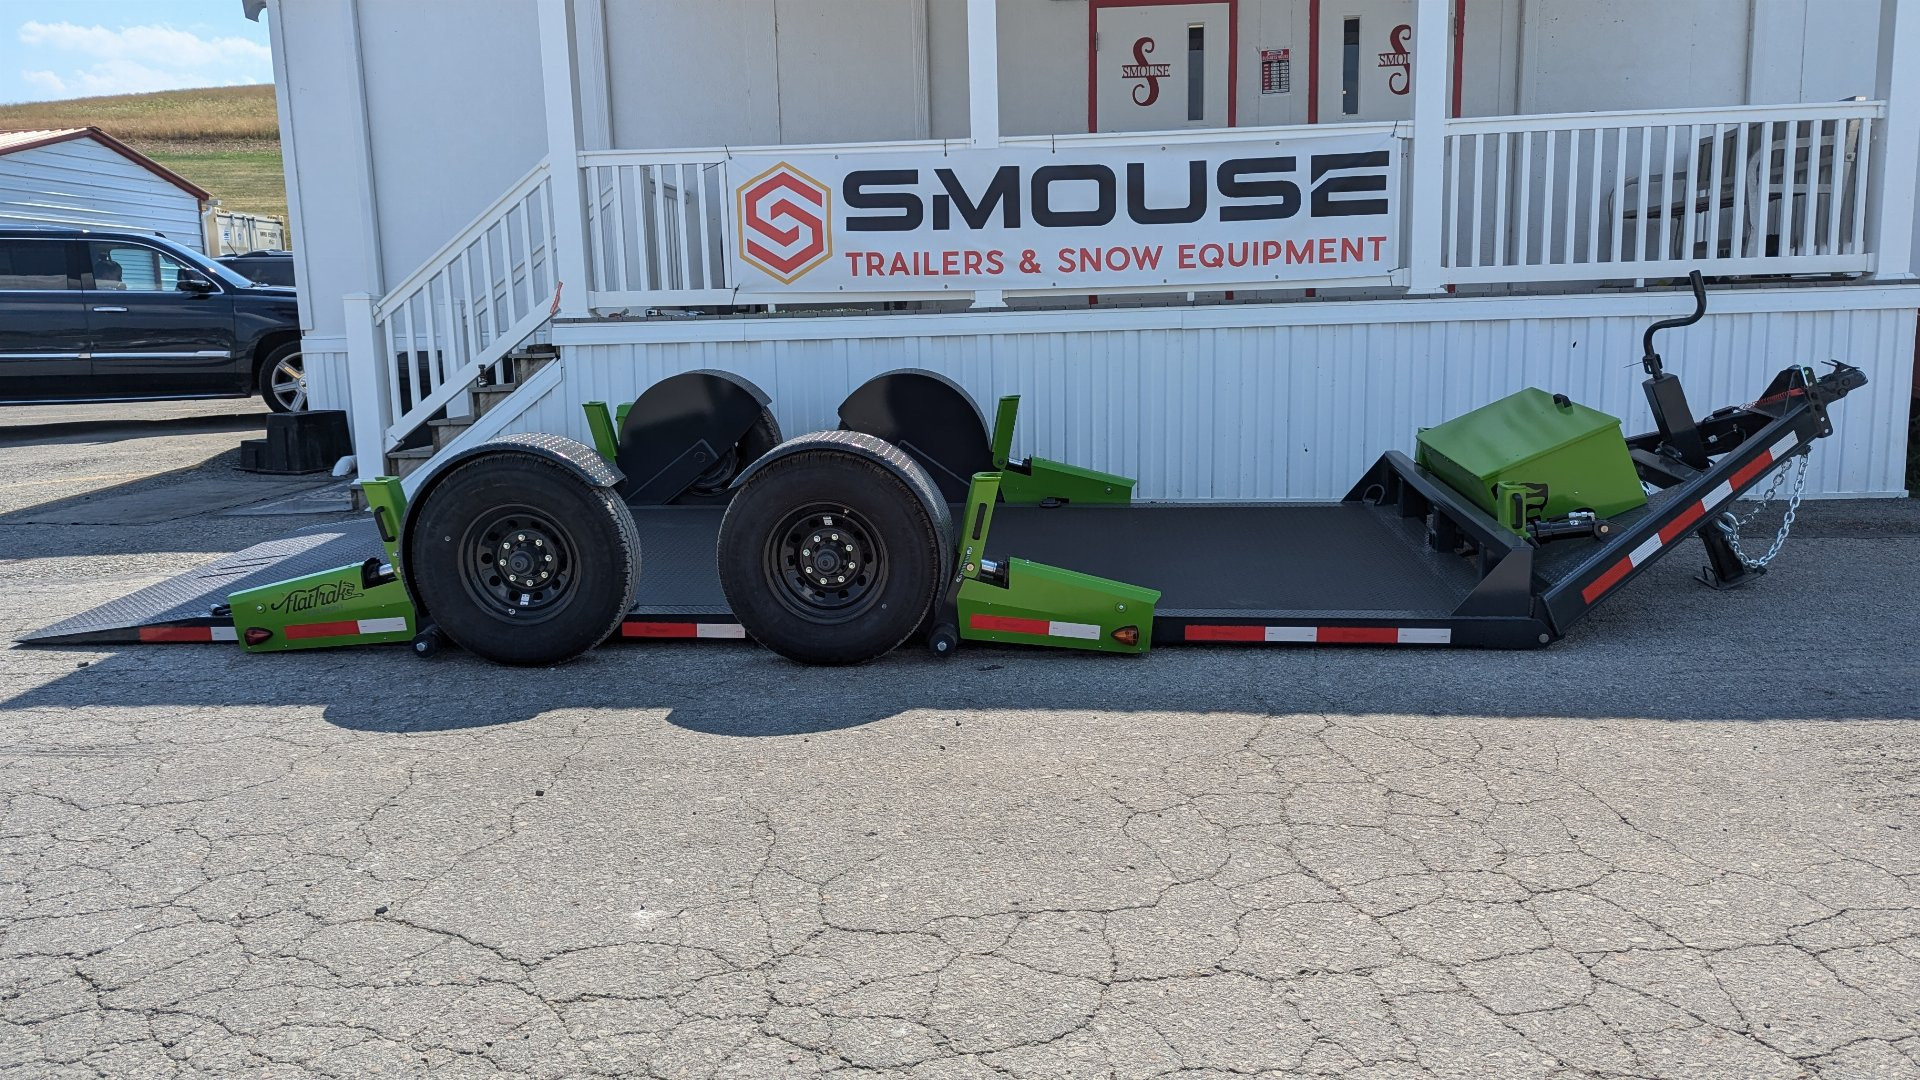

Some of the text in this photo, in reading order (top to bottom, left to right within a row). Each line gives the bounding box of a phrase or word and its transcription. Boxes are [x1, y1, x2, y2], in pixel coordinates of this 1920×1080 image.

[1122, 65, 1170, 77] SMOUSE
[1379, 53, 1410, 66] SMO
[843, 151, 1390, 232] SMOUSE
[846, 236, 1387, 276] TRAILERS & SNOW EQUIPMENT
